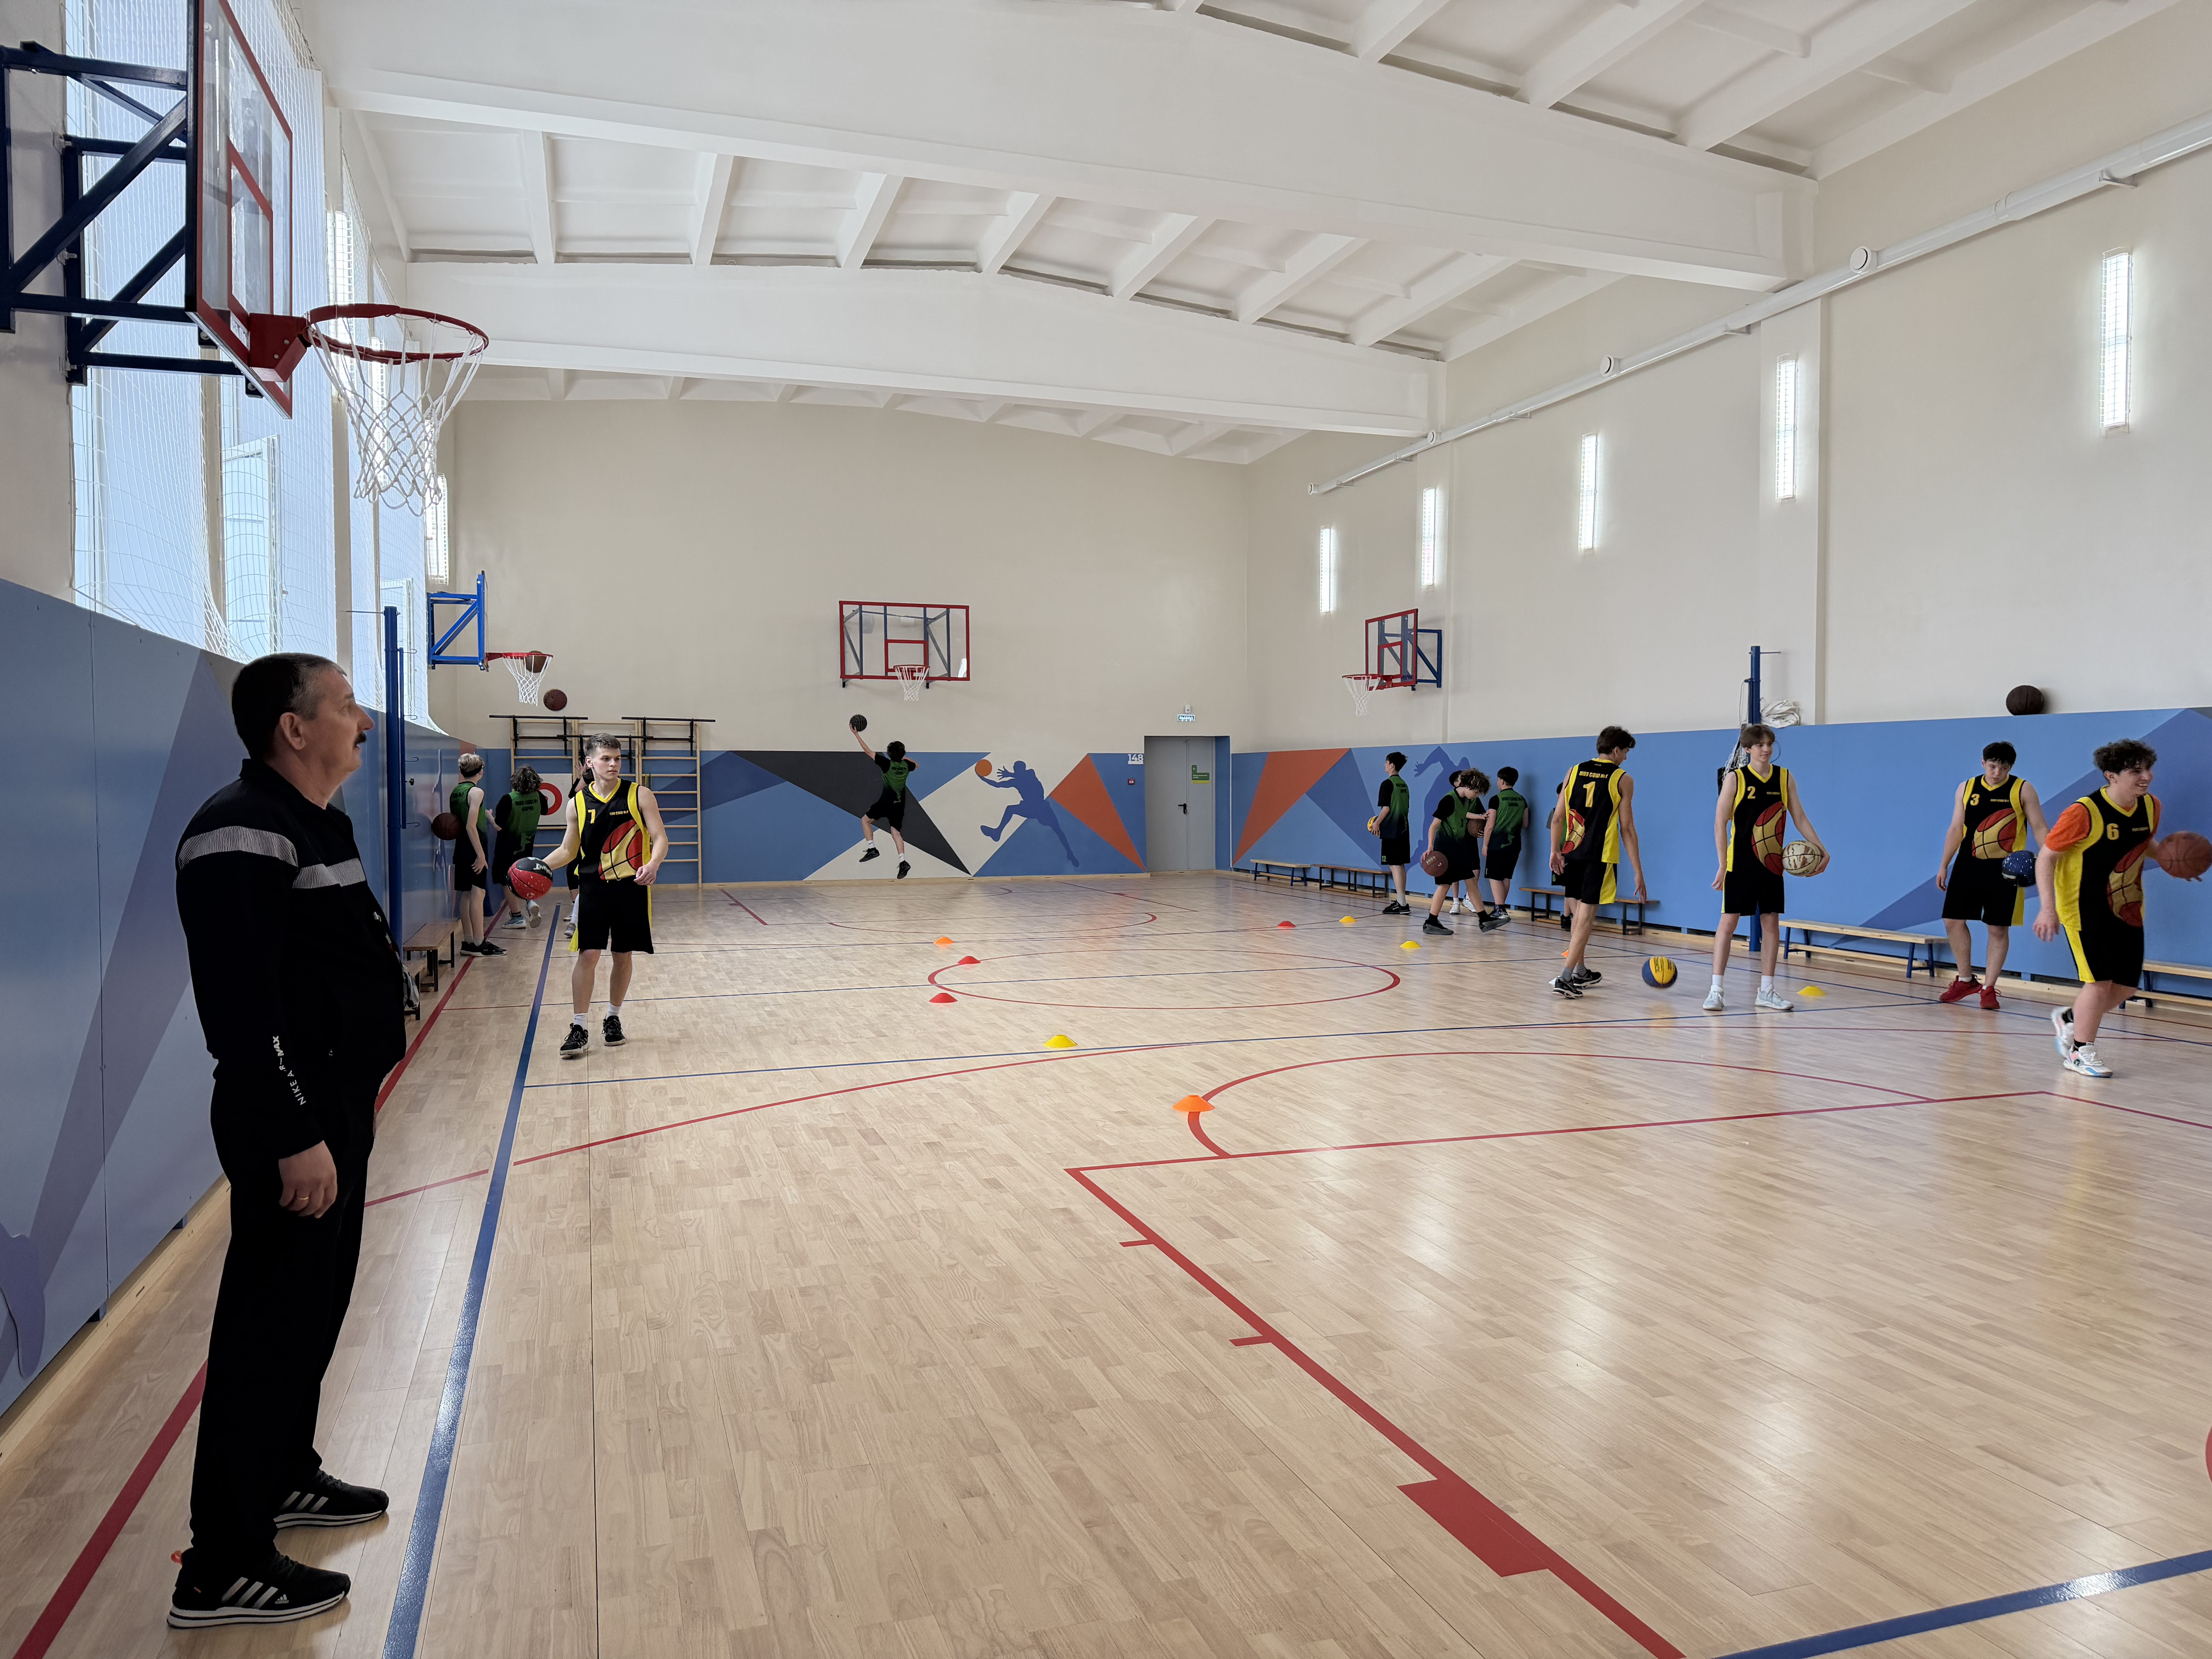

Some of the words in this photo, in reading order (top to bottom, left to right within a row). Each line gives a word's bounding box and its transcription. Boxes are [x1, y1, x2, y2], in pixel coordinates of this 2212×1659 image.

[1583, 781, 1596, 807] 1
[1747, 786, 1756, 799] 2
[1970, 793, 1980, 805] 3
[588, 809, 596, 824] 7
[2107, 823, 2119, 840] 6
[290, 1079, 306, 1106] NIKE
